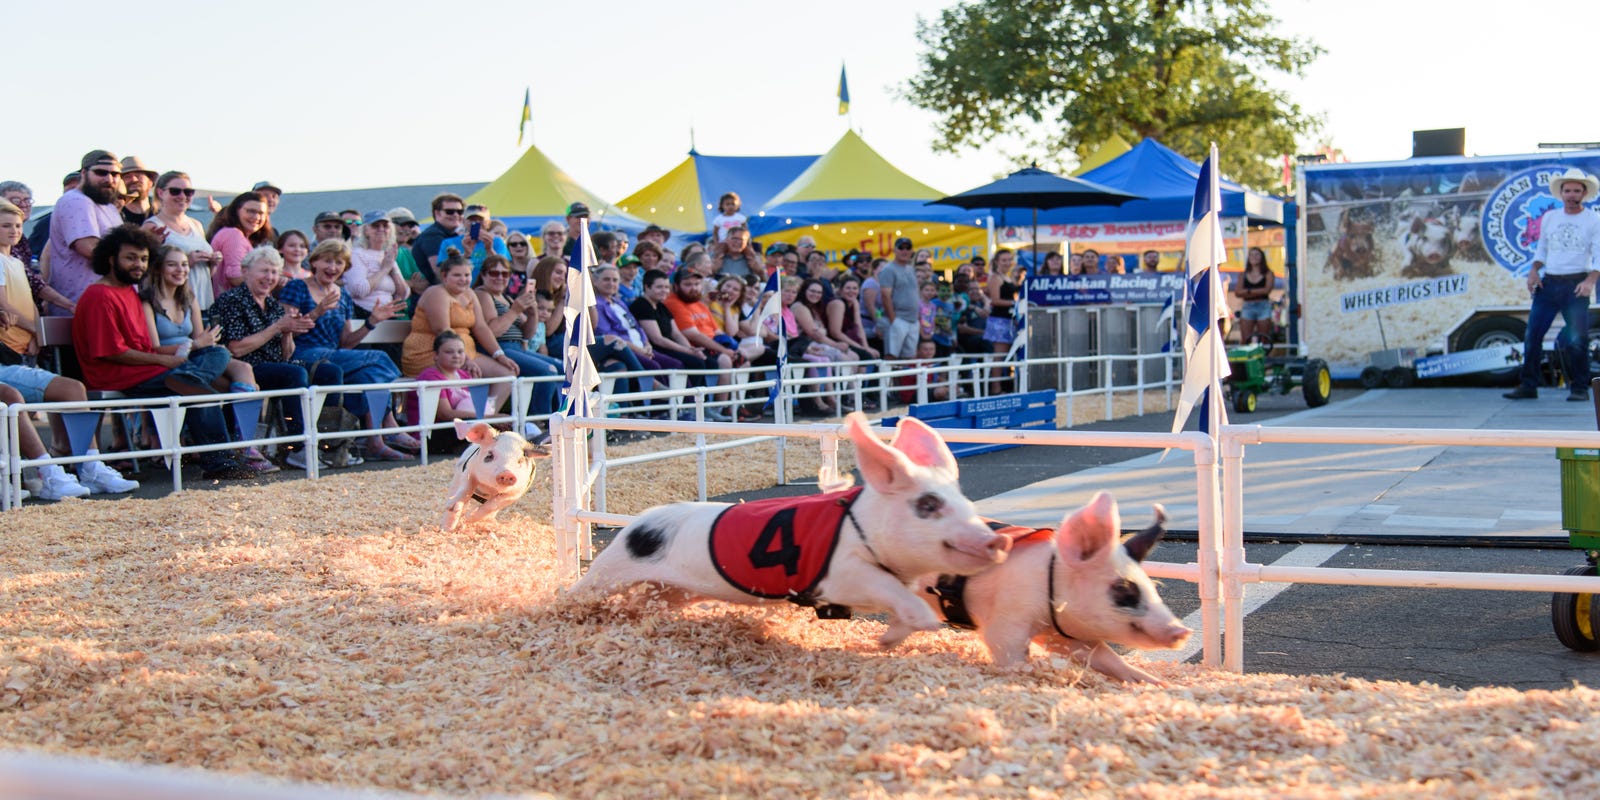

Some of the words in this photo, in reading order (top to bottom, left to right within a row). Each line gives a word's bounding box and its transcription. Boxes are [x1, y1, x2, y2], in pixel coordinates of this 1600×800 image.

[1050, 224, 1099, 238] Piggy
[1104, 221, 1186, 236] Boutique
[860, 233, 893, 258] FU
[1029, 276, 1107, 291] All-Alaskan
[1109, 275, 1158, 290] Racing
[1344, 289, 1391, 310] WHERE
[1398, 283, 1431, 302] PIGS
[1437, 277, 1465, 294] FLY!
[748, 507, 801, 577] 4
